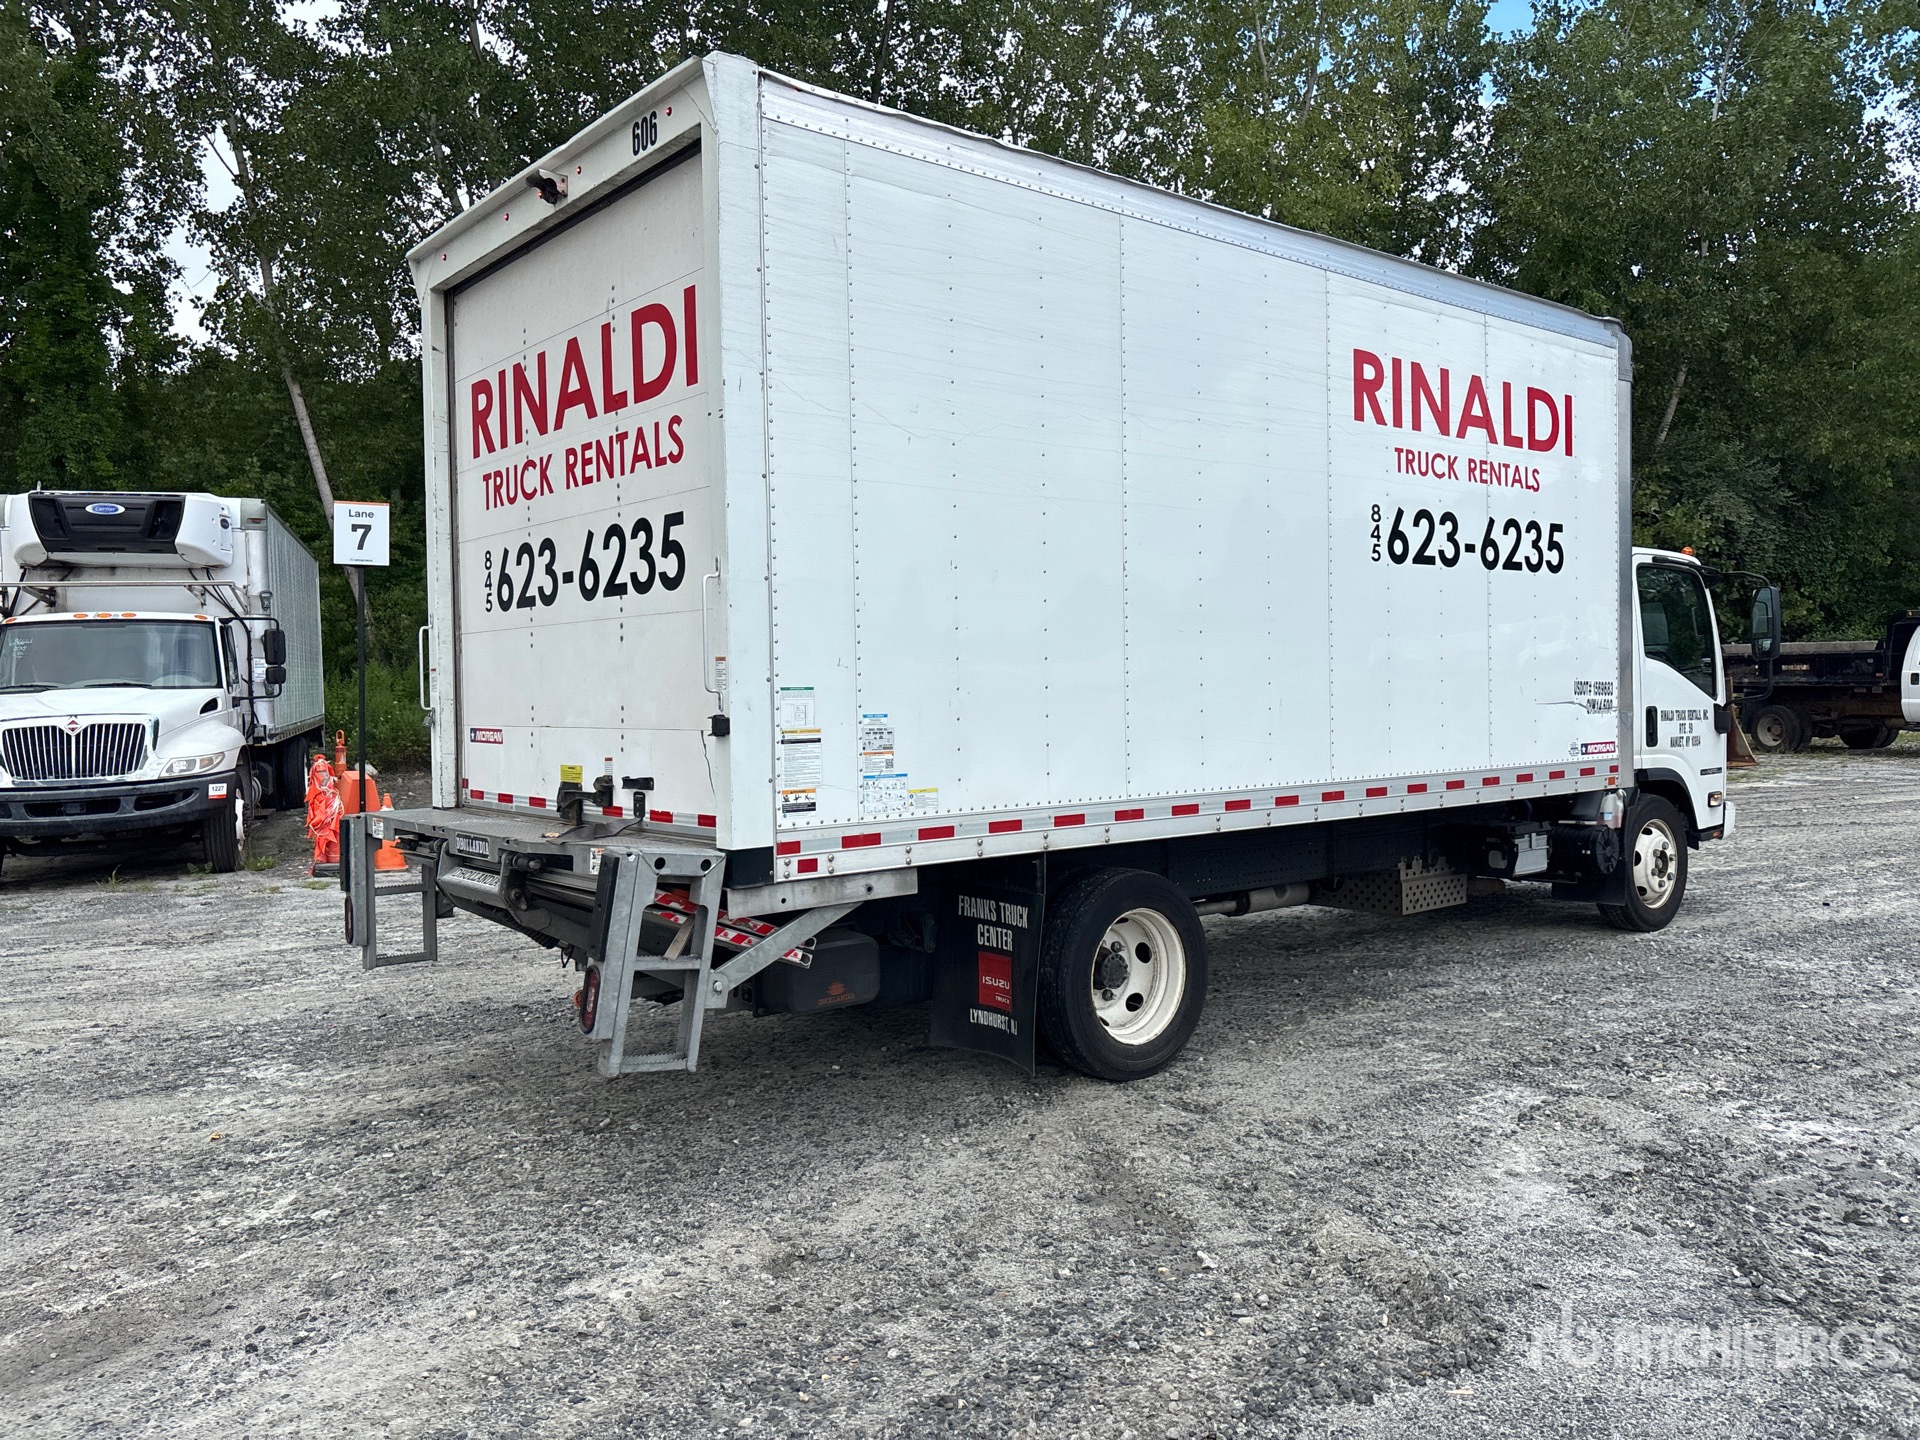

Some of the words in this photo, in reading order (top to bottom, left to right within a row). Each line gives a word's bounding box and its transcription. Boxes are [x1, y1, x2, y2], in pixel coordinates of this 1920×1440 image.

[632, 111, 657, 156] 606
[471, 284, 699, 459] RINALDI
[1353, 348, 1573, 457] RINALDI
[483, 453, 554, 510] TRUCK
[565, 415, 684, 490] RENTALS
[1394, 447, 1459, 481] TRUCK
[1467, 458, 1540, 492] RENTALS
[348, 509, 375, 518] Lane
[351, 523, 372, 551] 7
[1387, 507, 1564, 573] 623-6235
[497, 511, 686, 612] 623-6235
[476, 730, 503, 742] MORGAN
[1587, 742, 1615, 753] MORGAN
[452, 868, 500, 887] DHOLLANDIA
[958, 895, 997, 922] FRANKS
[999, 902, 1029, 929] TRUCK
[977, 923, 1013, 952] CENTER
[982, 975, 1010, 990] ISUZU
[970, 1008, 1010, 1034] LYNDHURST,
[1010, 1018, 1018, 1036] NJ
